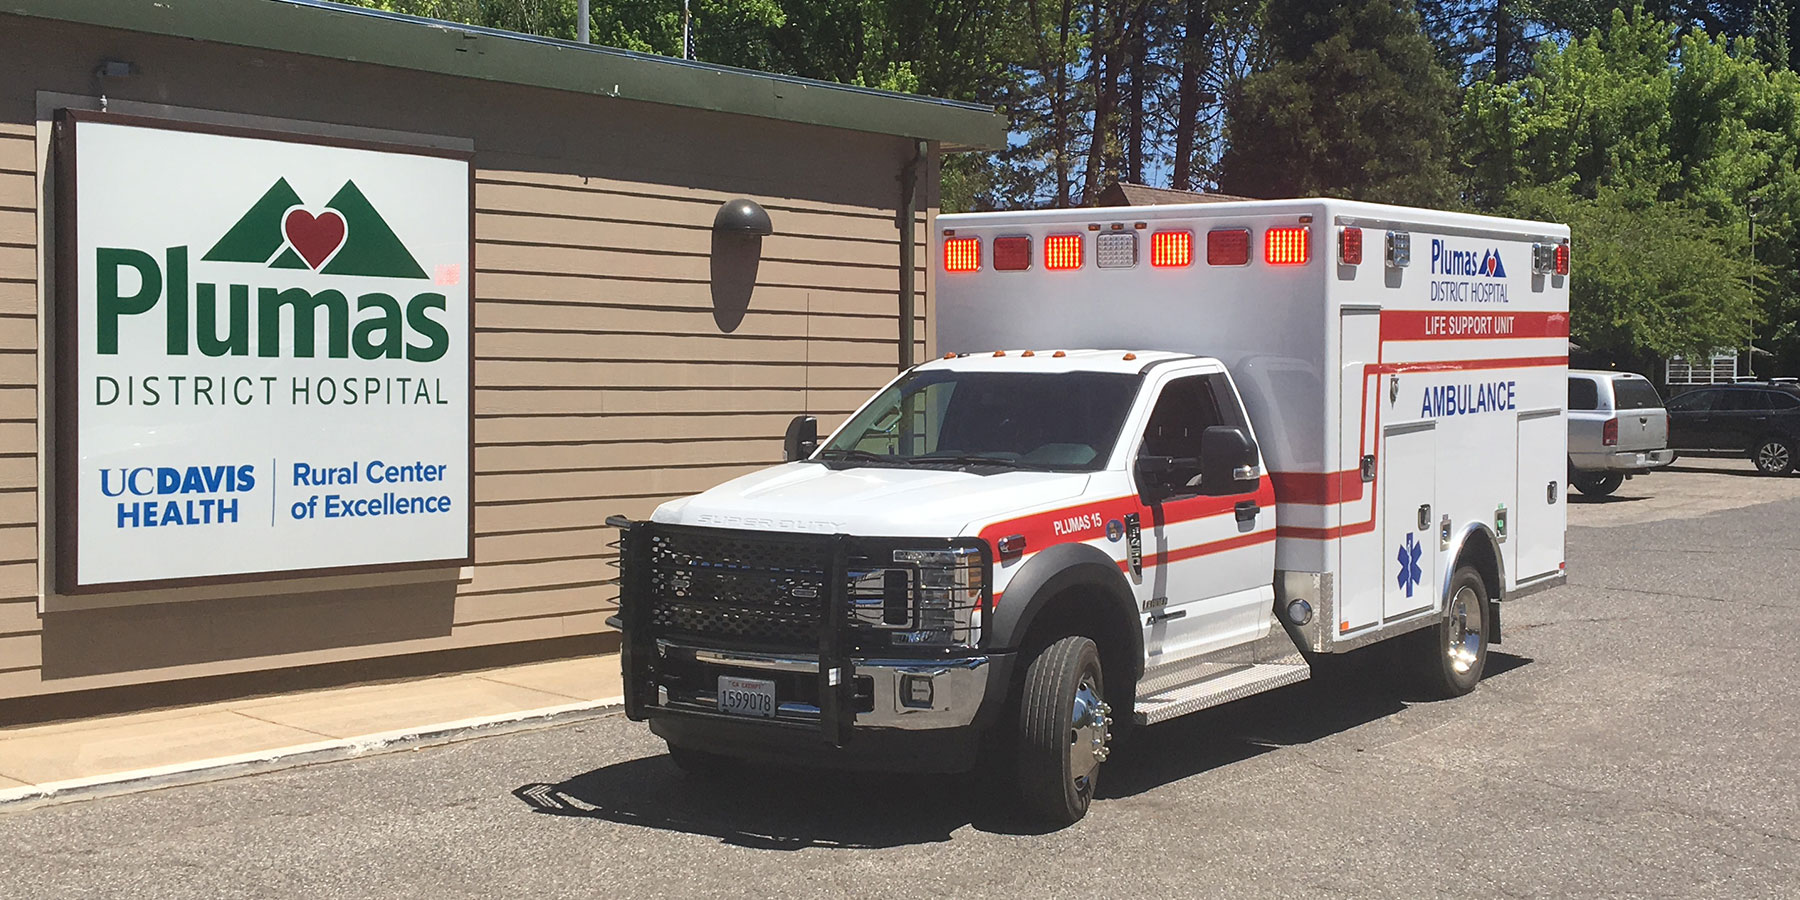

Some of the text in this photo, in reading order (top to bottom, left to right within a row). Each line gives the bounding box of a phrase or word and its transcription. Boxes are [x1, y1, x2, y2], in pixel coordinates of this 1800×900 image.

[1431, 238, 1478, 277] Plumas
[95, 245, 450, 363] Plumas
[1431, 281, 1508, 303] DISTRICT HOSPITAL
[1425, 315, 1515, 335] LIFE SUPPORT UNIT
[96, 375, 449, 406] DISTRICT HOSPITAL
[1421, 380, 1517, 418] AMBULANCE
[293, 460, 447, 487] Rural Center
[117, 498, 239, 529] HEALTH
[290, 492, 452, 520] of Excellence
[698, 513, 847, 530] SUPER DUTY
[1053, 512, 1103, 536] PLUMAS 15
[722, 689, 771, 712] 1599078
